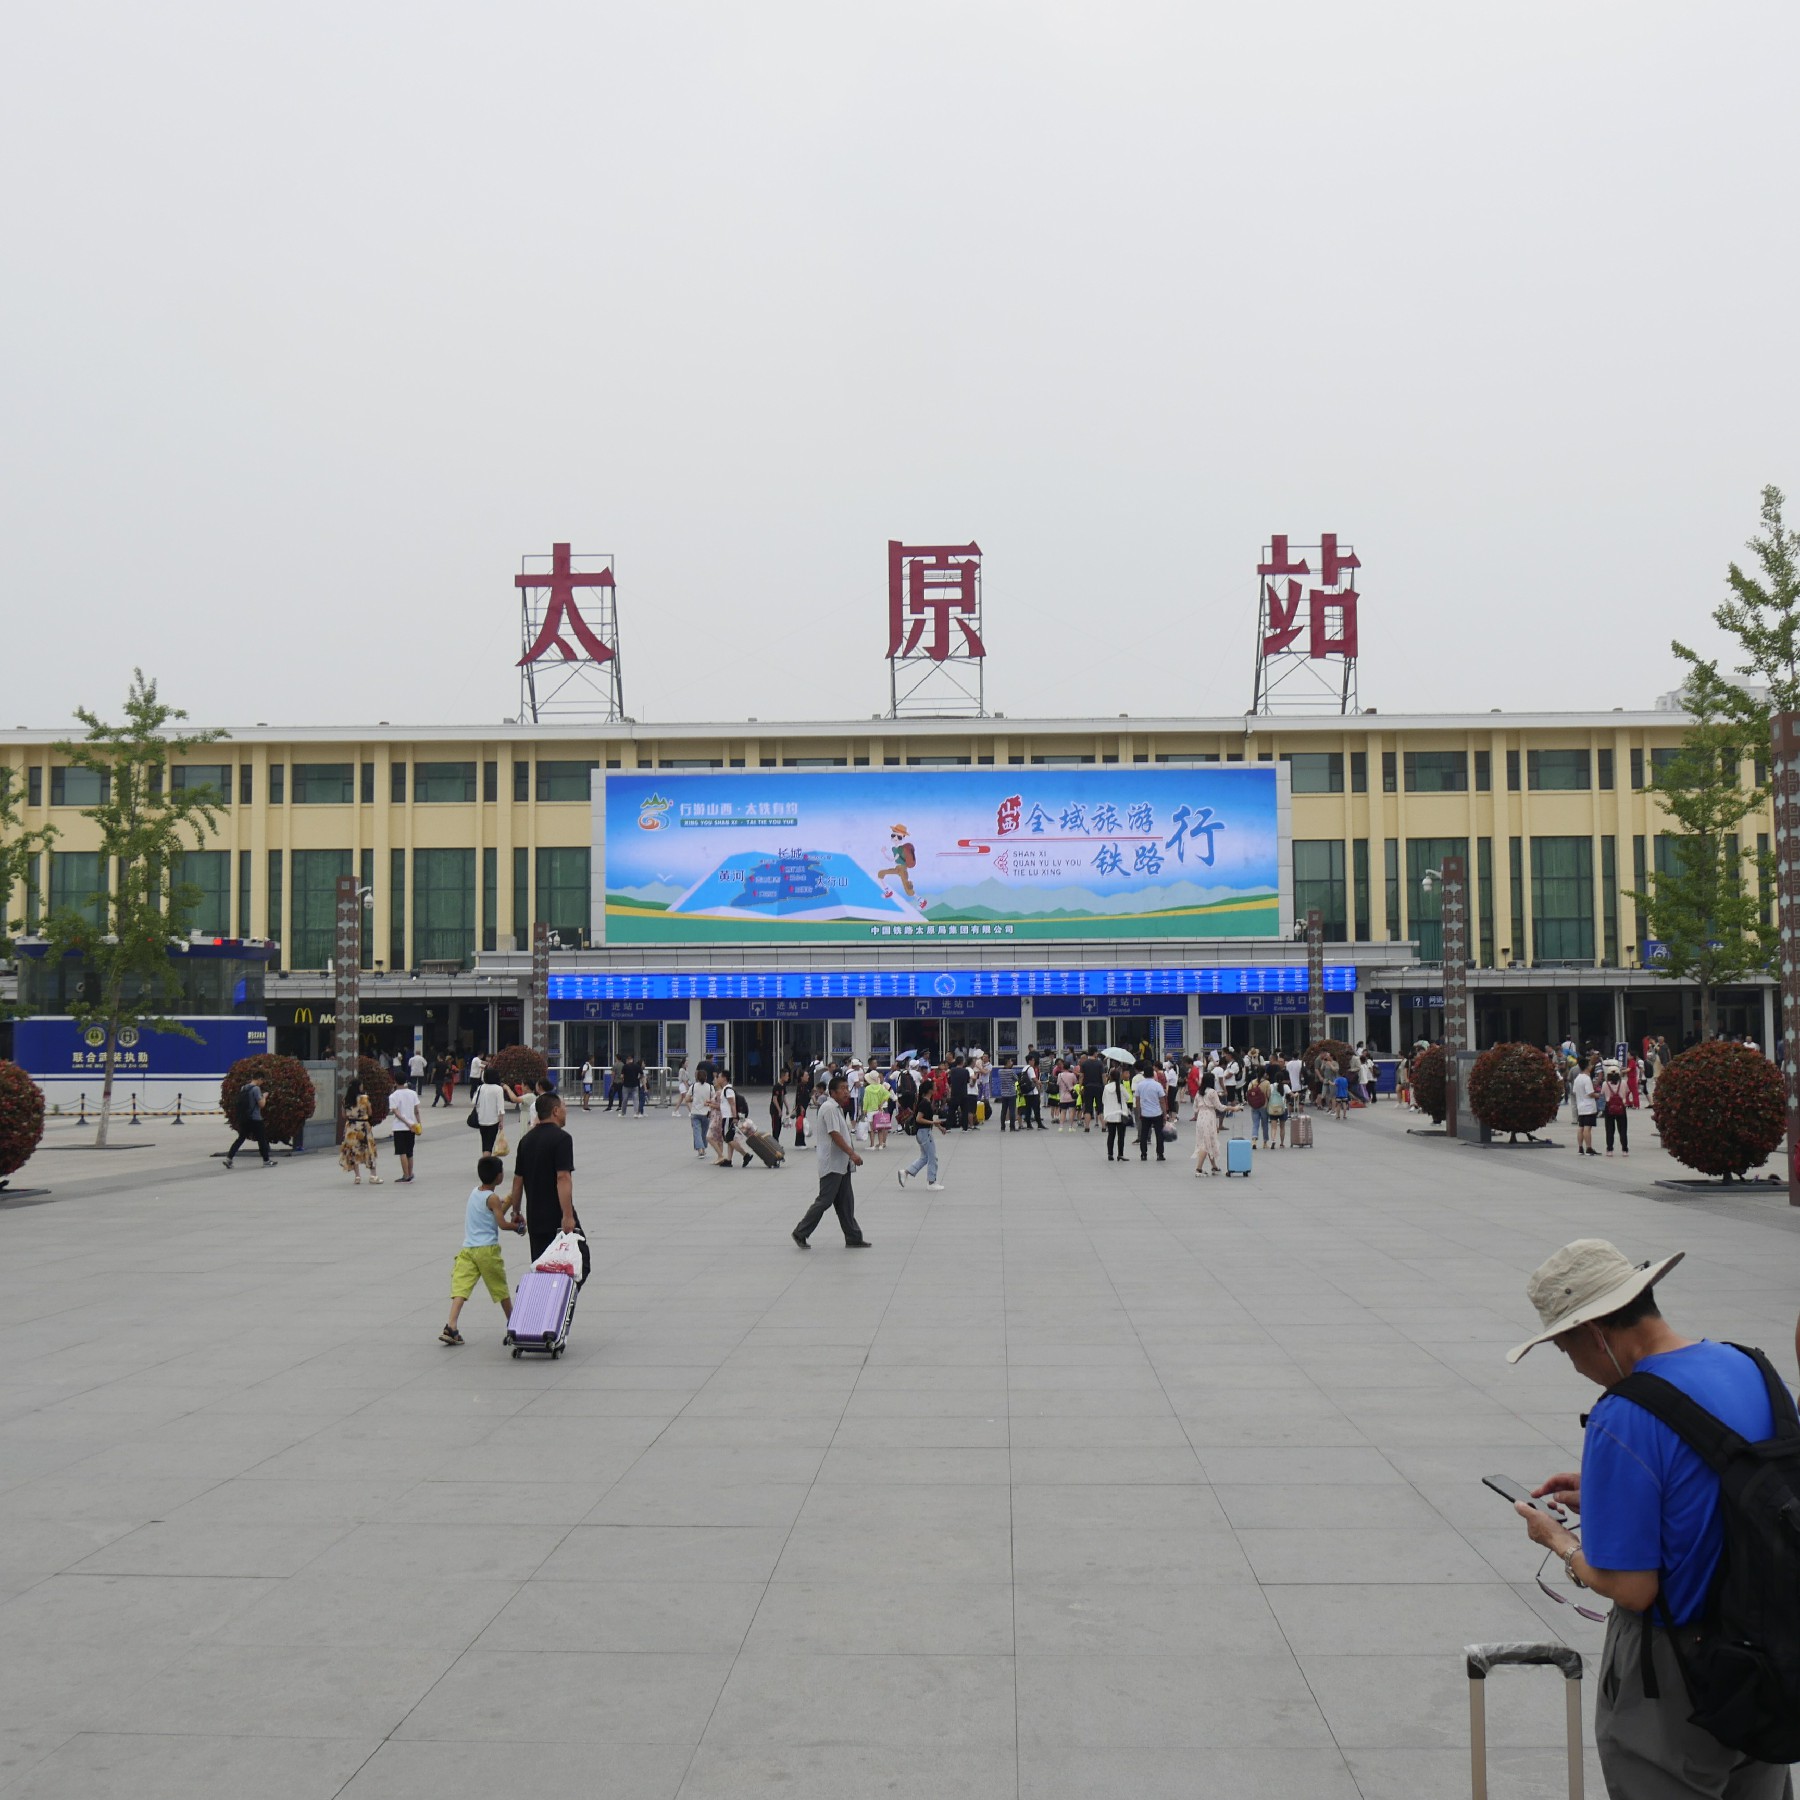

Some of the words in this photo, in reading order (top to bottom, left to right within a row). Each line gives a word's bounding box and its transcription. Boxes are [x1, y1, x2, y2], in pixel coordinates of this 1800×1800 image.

[515, 533, 1360, 666] 太原站
[1002, 801, 1018, 830] 山西
[1025, 803, 1153, 834] 全域旅游
[1165, 805, 1225, 867] 行
[778, 848, 802, 860] 长城
[1090, 843, 1165, 877] 铁路
[719, 870, 745, 882] 黄河
[870, 925, 1015, 936] 中国铁路太原局集团有限公司
[777, 1001, 809, 1010] 进站口
[942, 999, 974, 1008] 进站口
[1108, 997, 1141, 1006] 进站口
[1274, 995, 1307, 1005] 进站口
[612, 1002, 644, 1011] 进站口
[319, 1013, 394, 1024] Mcnald's
[72, 1052, 148, 1063] 联合武装执勤
